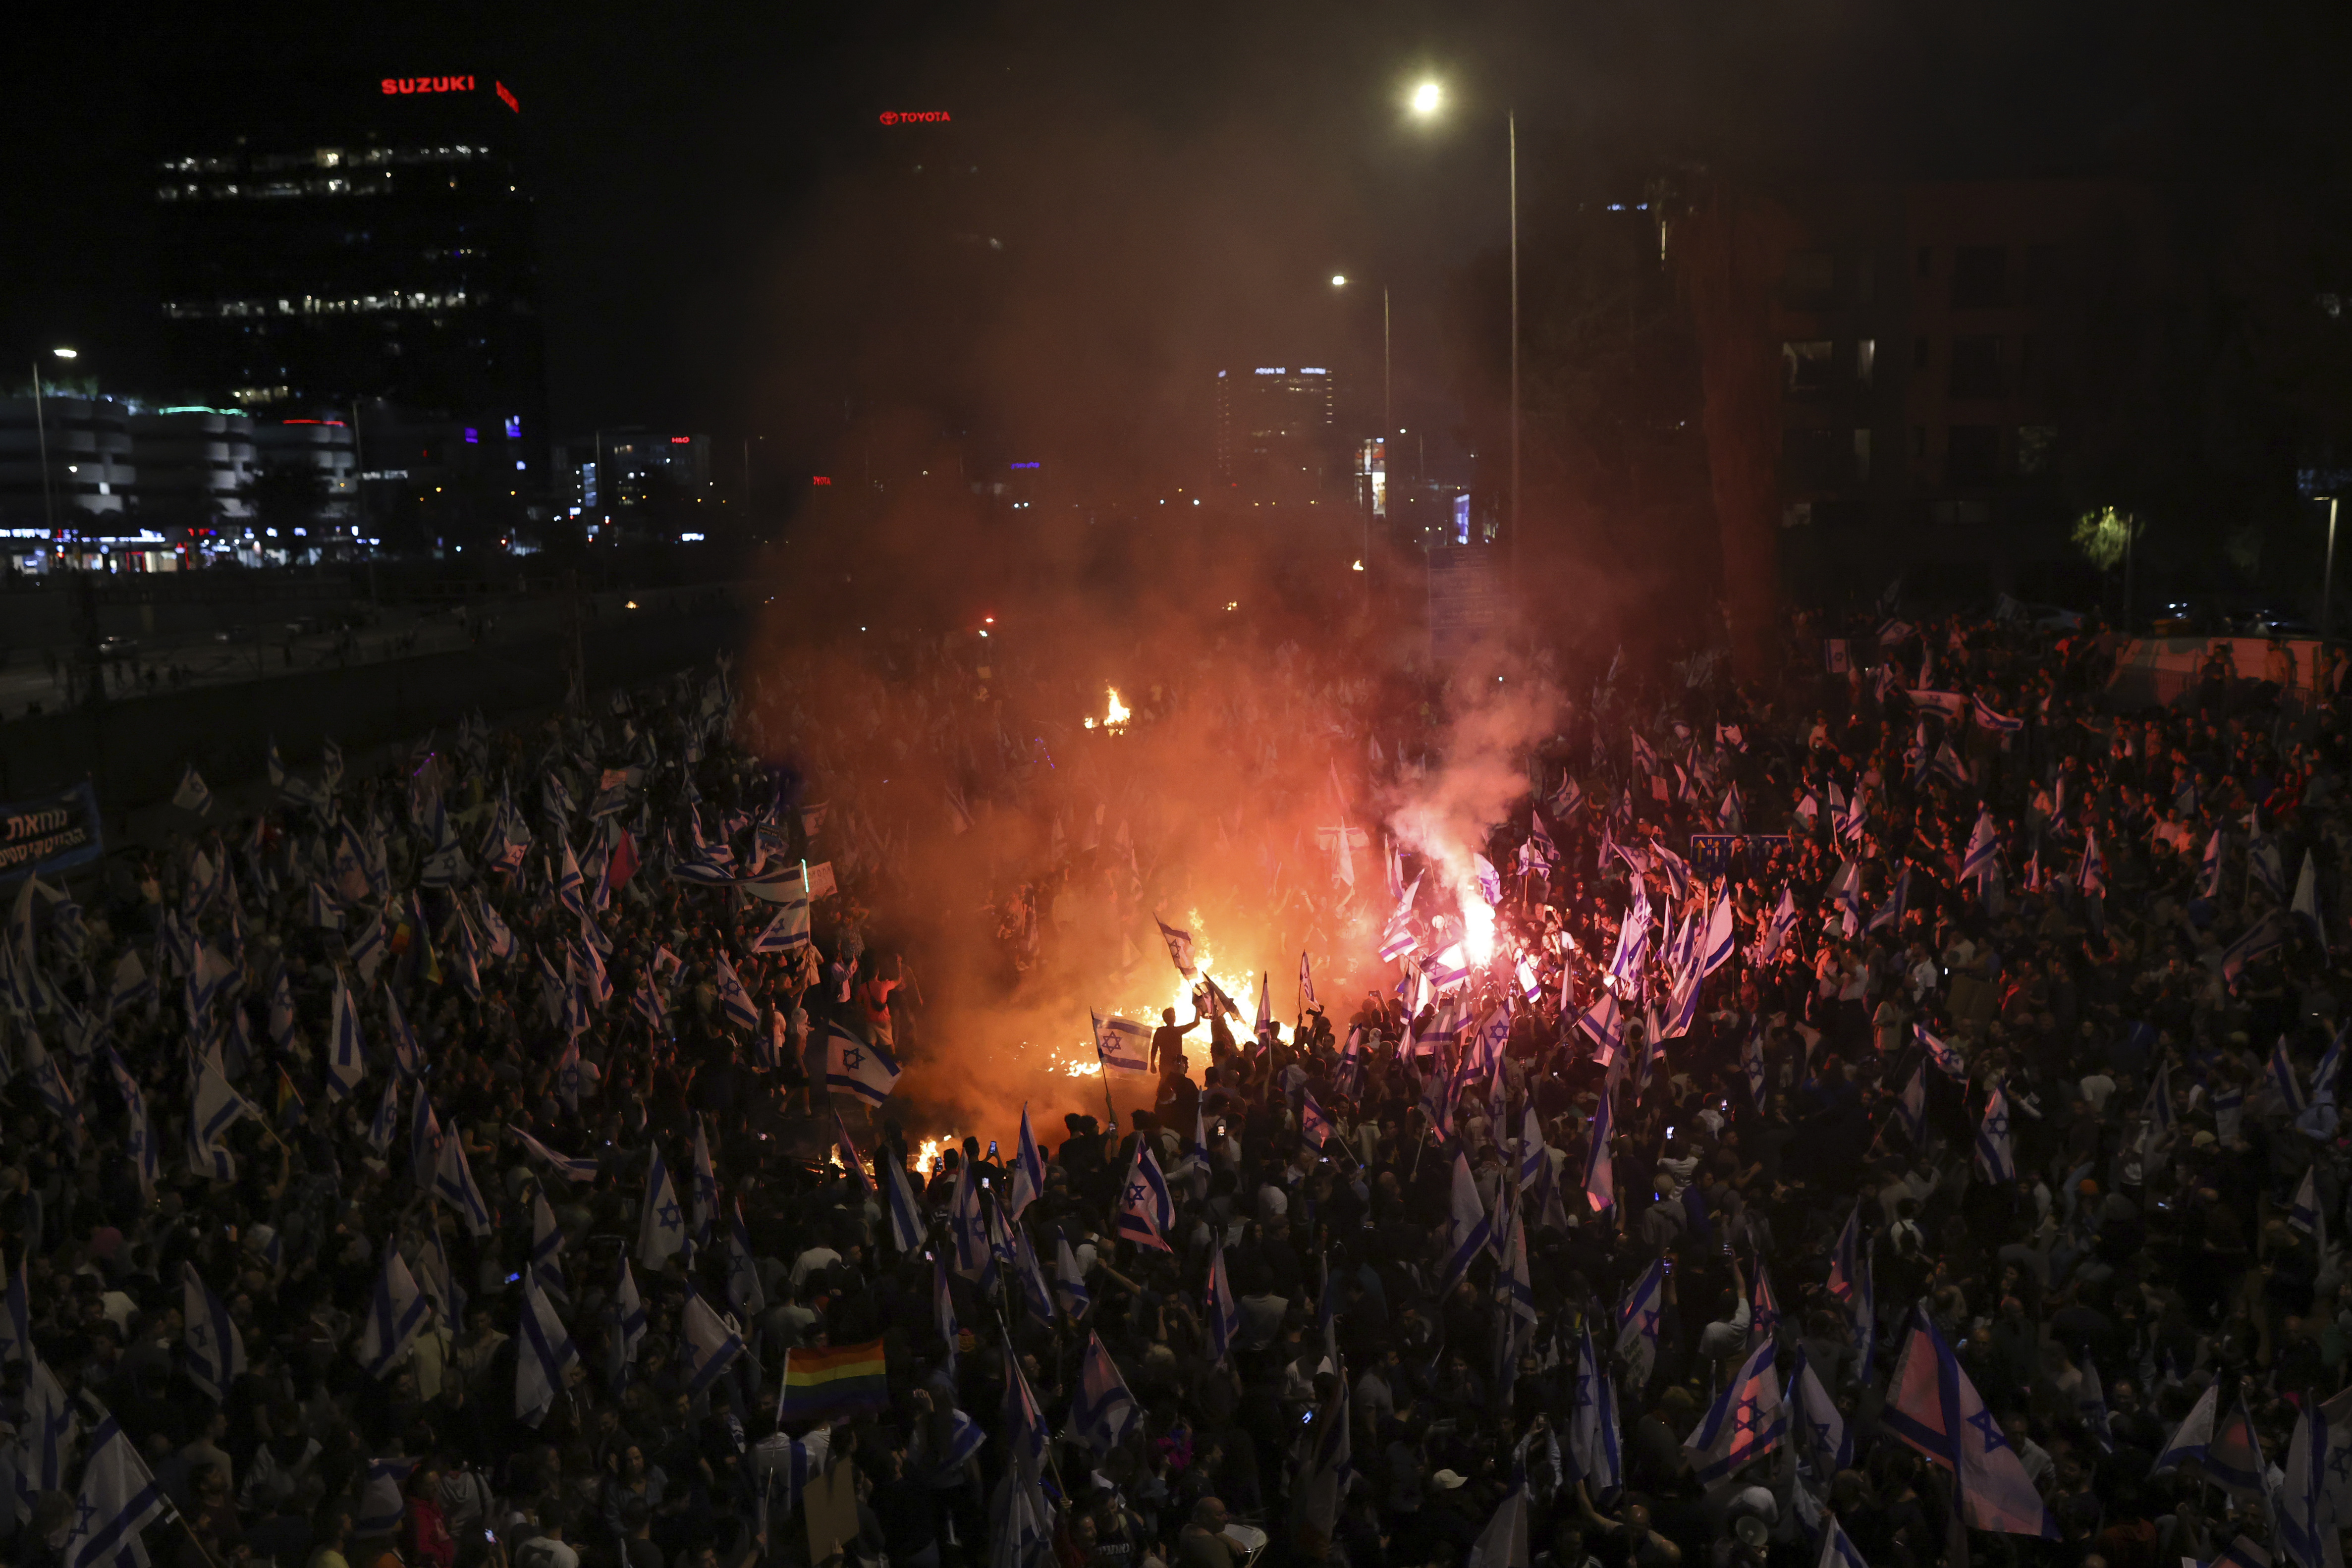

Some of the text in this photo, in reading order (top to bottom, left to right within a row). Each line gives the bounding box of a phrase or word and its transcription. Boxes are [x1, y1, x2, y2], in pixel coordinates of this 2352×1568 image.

[381, 75, 475, 95] SUZUKI
[899, 111, 951, 123] TOYOTA
[6, 809, 67, 841] מחאת
